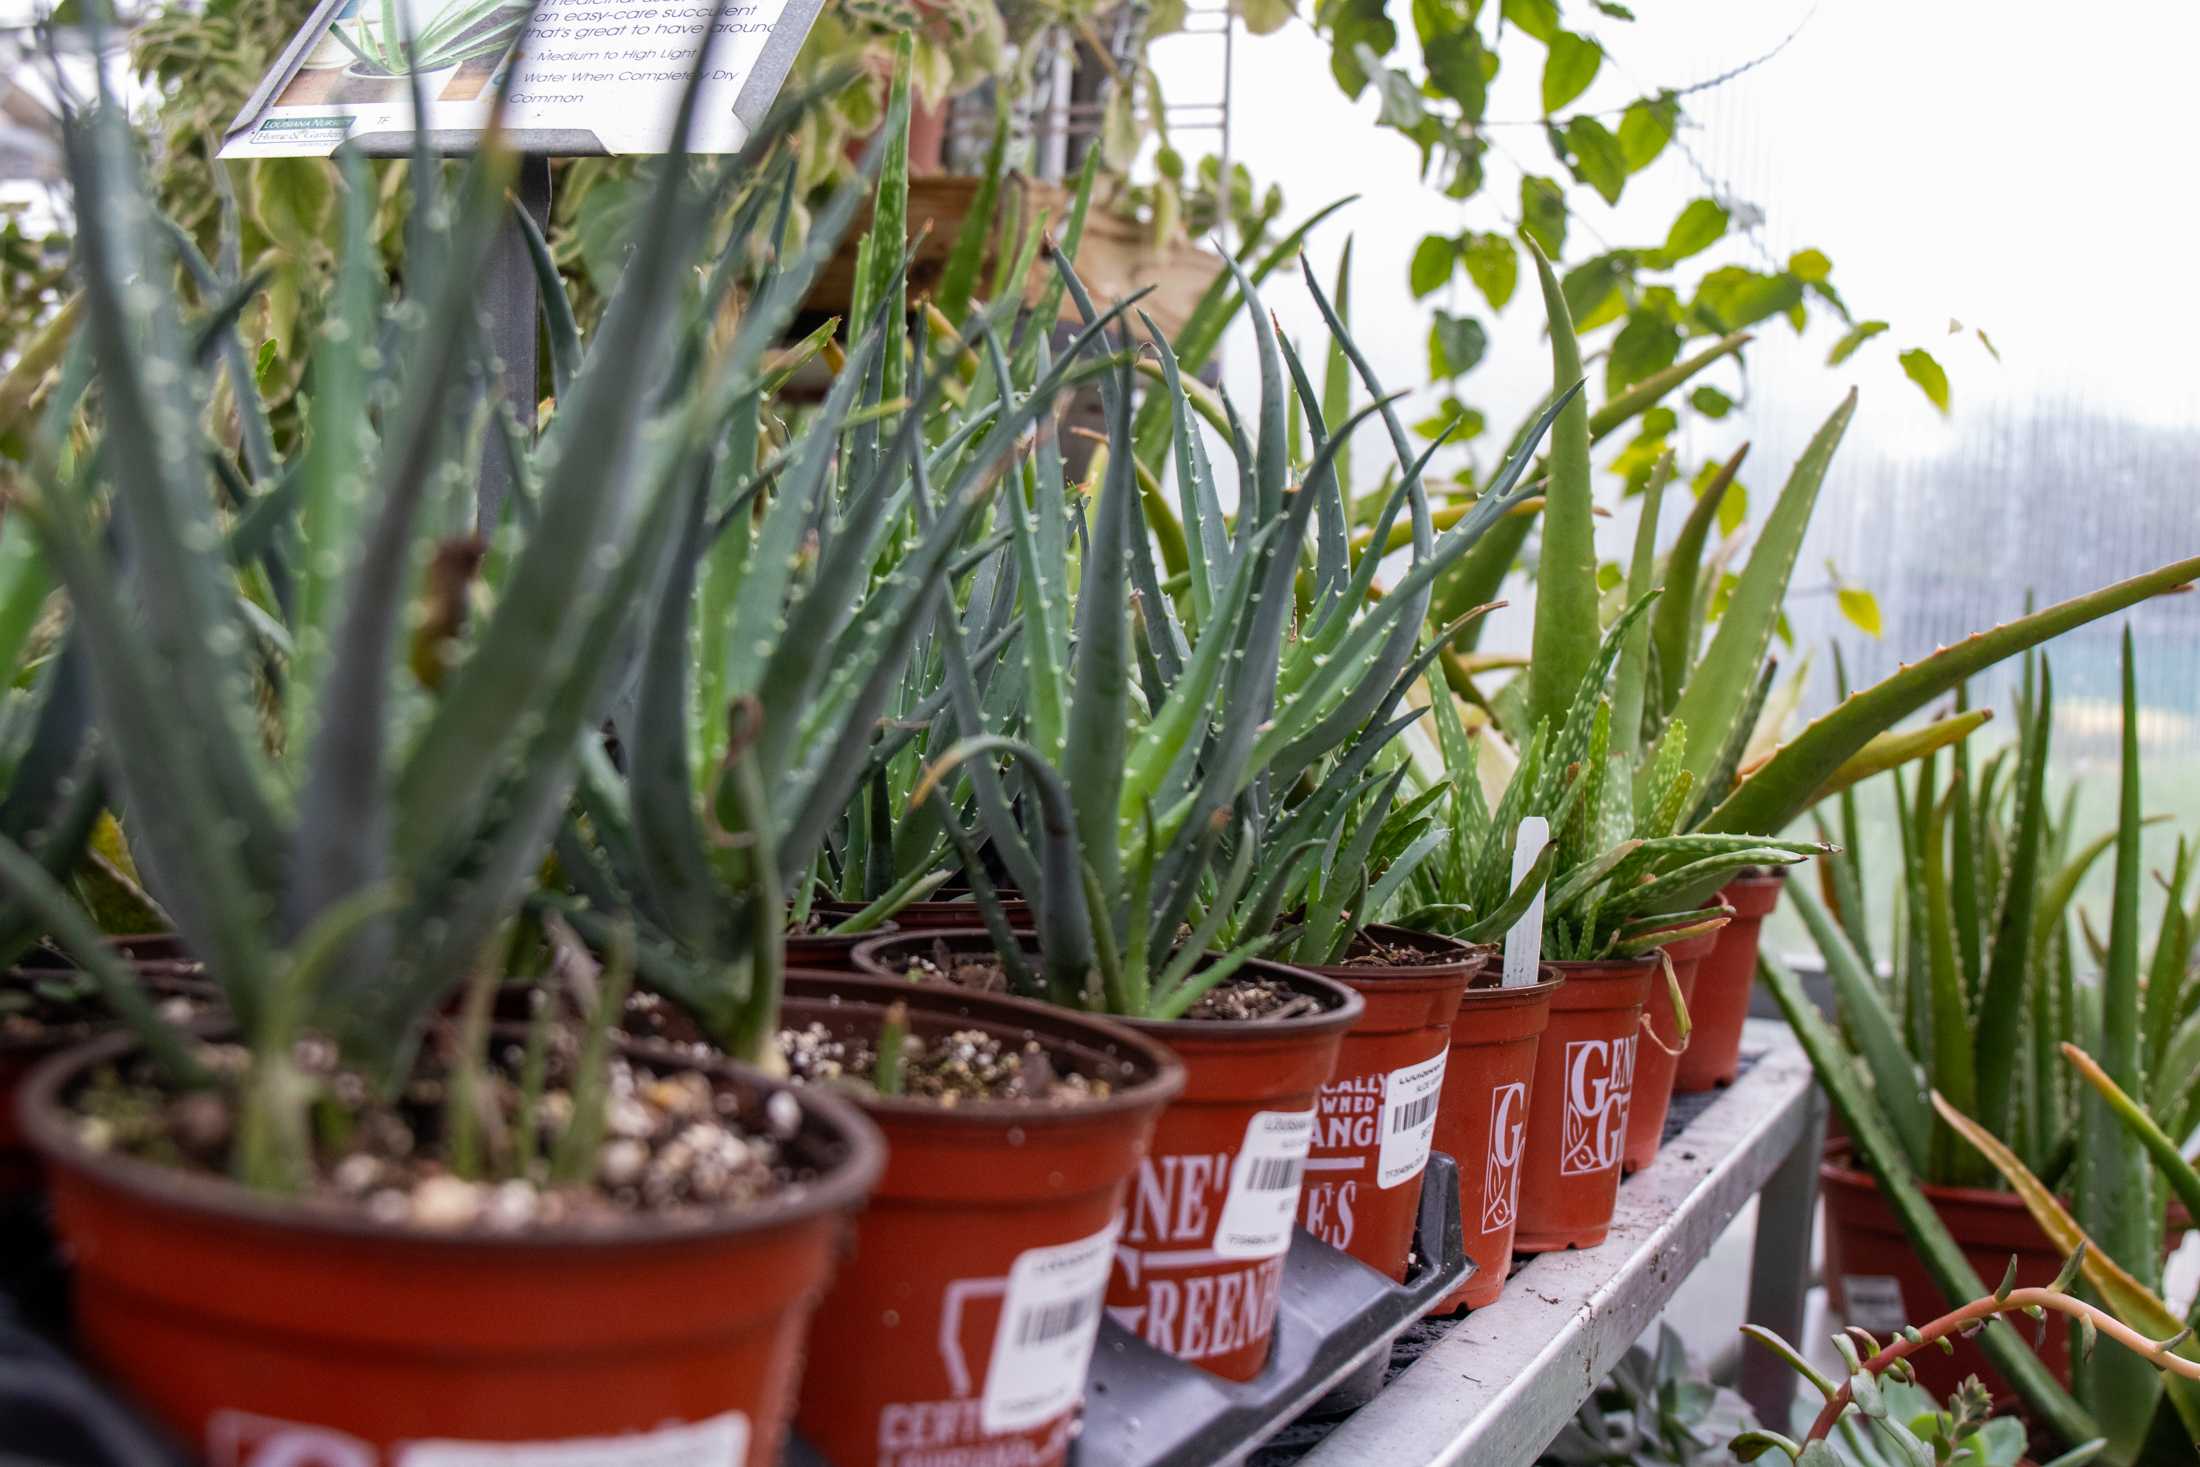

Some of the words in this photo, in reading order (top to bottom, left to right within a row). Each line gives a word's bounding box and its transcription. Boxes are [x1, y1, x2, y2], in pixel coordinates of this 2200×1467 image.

[534, 12, 559, 22] an
[564, 9, 658, 23] easy-care
[575, 24, 627, 40] great
[632, 24, 650, 35] to
[655, 23, 704, 34] have
[537, 49, 599, 61] Medium
[605, 50, 618, 60] to
[622, 48, 657, 61] High
[660, 48, 697, 60] Light
[524, 72, 566, 83] Water
[572, 72, 614, 81] When
[618, 71, 710, 82] Completey
[712, 70, 738, 80] Dry
[509, 93, 584, 104] Common
